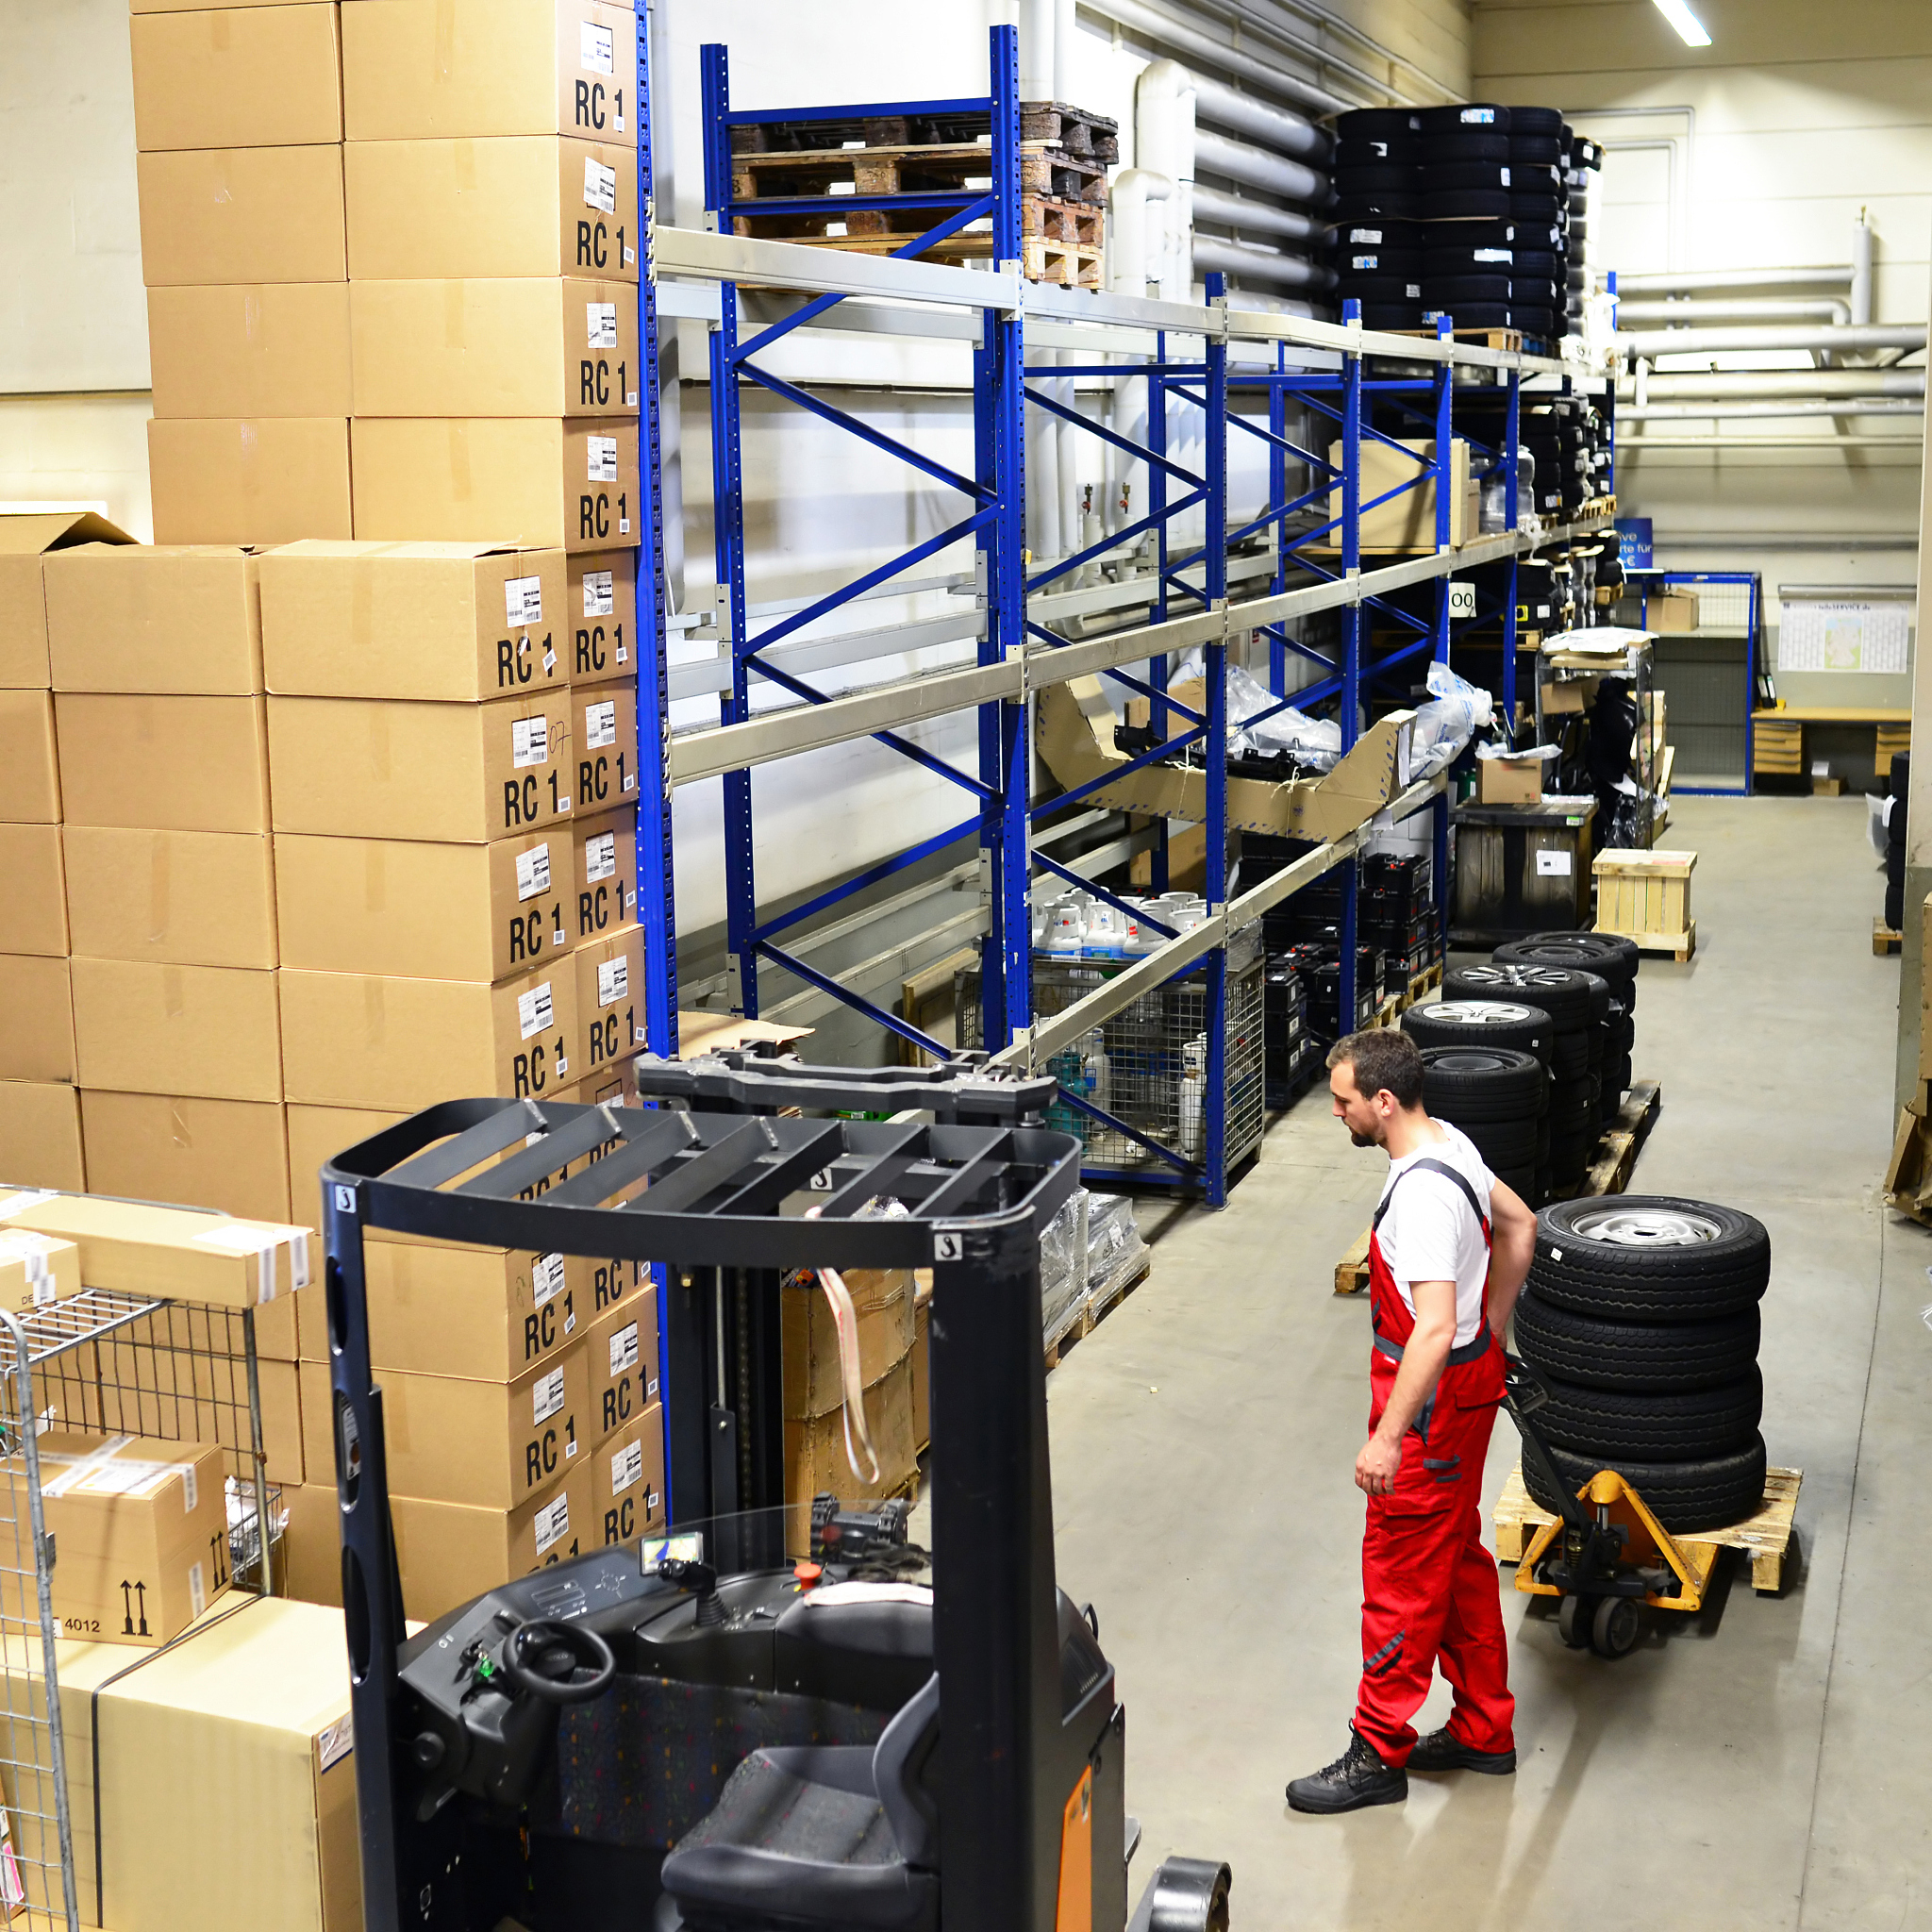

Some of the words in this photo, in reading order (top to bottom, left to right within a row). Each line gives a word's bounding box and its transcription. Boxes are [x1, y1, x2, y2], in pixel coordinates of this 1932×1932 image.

[575, 79, 606, 130] RC
[614, 89, 623, 133] 1
[576, 220, 608, 268] RC
[616, 225, 625, 270] 1
[580, 359, 609, 406] RC
[618, 360, 626, 405] 1
[580, 493, 609, 539] RC
[618, 492, 626, 535] 1
[497, 636, 532, 688] RC
[542, 632, 553, 677] 1
[575, 625, 606, 675] RC
[613, 624, 623, 666] 1
[504, 774, 539, 828] RC
[547, 769, 558, 815] 1
[579, 756, 608, 806] RC
[616, 752, 625, 793] 1
[509, 909, 542, 964] RC
[551, 903, 561, 946] 1
[578, 886, 608, 937] RC
[616, 879, 625, 922] 1
[590, 1013, 619, 1066] RC
[625, 1006, 634, 1047] 1
[513, 1045, 546, 1098] RC
[555, 1036, 565, 1080] 1
[594, 1258, 623, 1312] RC
[525, 1303, 556, 1361] RC
[563, 1290, 574, 1334] 1
[603, 1377, 631, 1433] RC
[638, 1364, 647, 1405] 1
[526, 1428, 558, 1489] RC
[565, 1415, 575, 1451] 1
[605, 1497, 635, 1546] RC
[642, 1483, 652, 1523] 1
[65, 1618, 100, 1633] 4012
